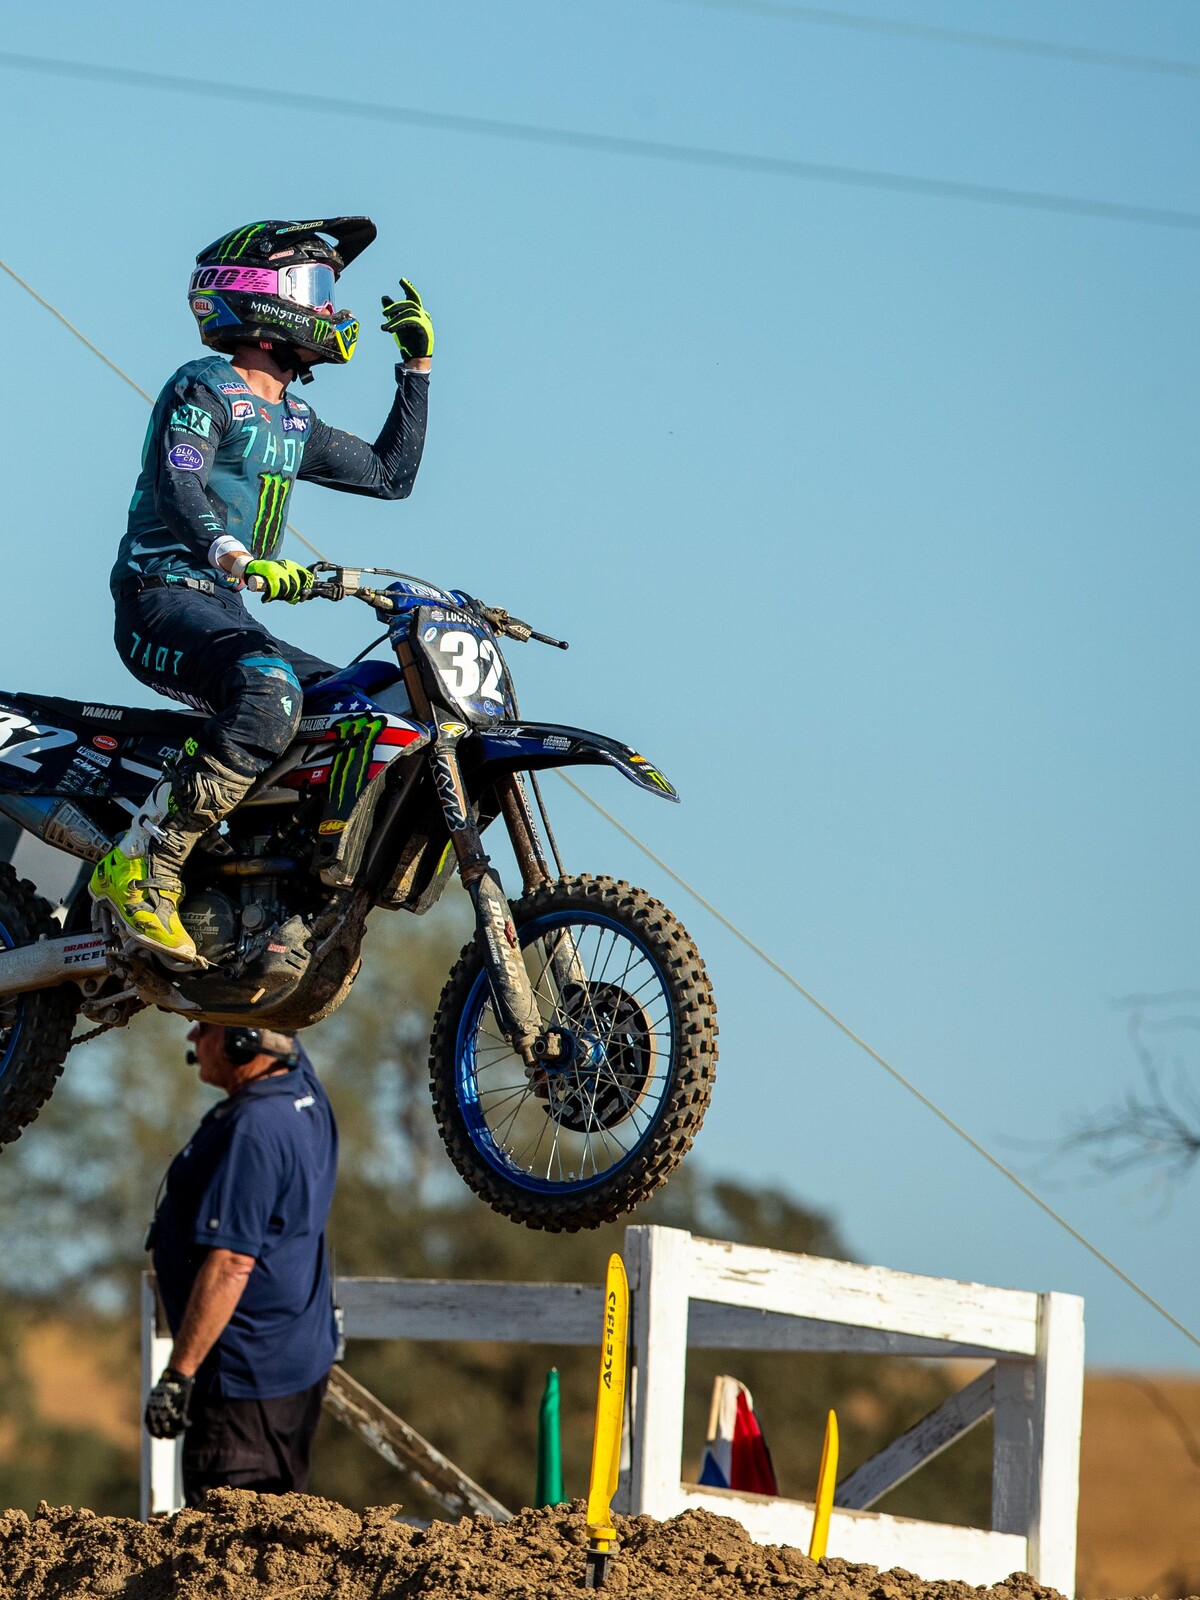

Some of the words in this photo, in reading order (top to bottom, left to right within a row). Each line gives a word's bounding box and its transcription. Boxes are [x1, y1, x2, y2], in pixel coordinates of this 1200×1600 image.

[191, 267, 272, 291] 100%
[194, 301, 211, 311] BELL
[439, 631, 504, 705] 32
[81, 705, 124, 721] YAMAHA
[63, 949, 107, 965] EXCEL
